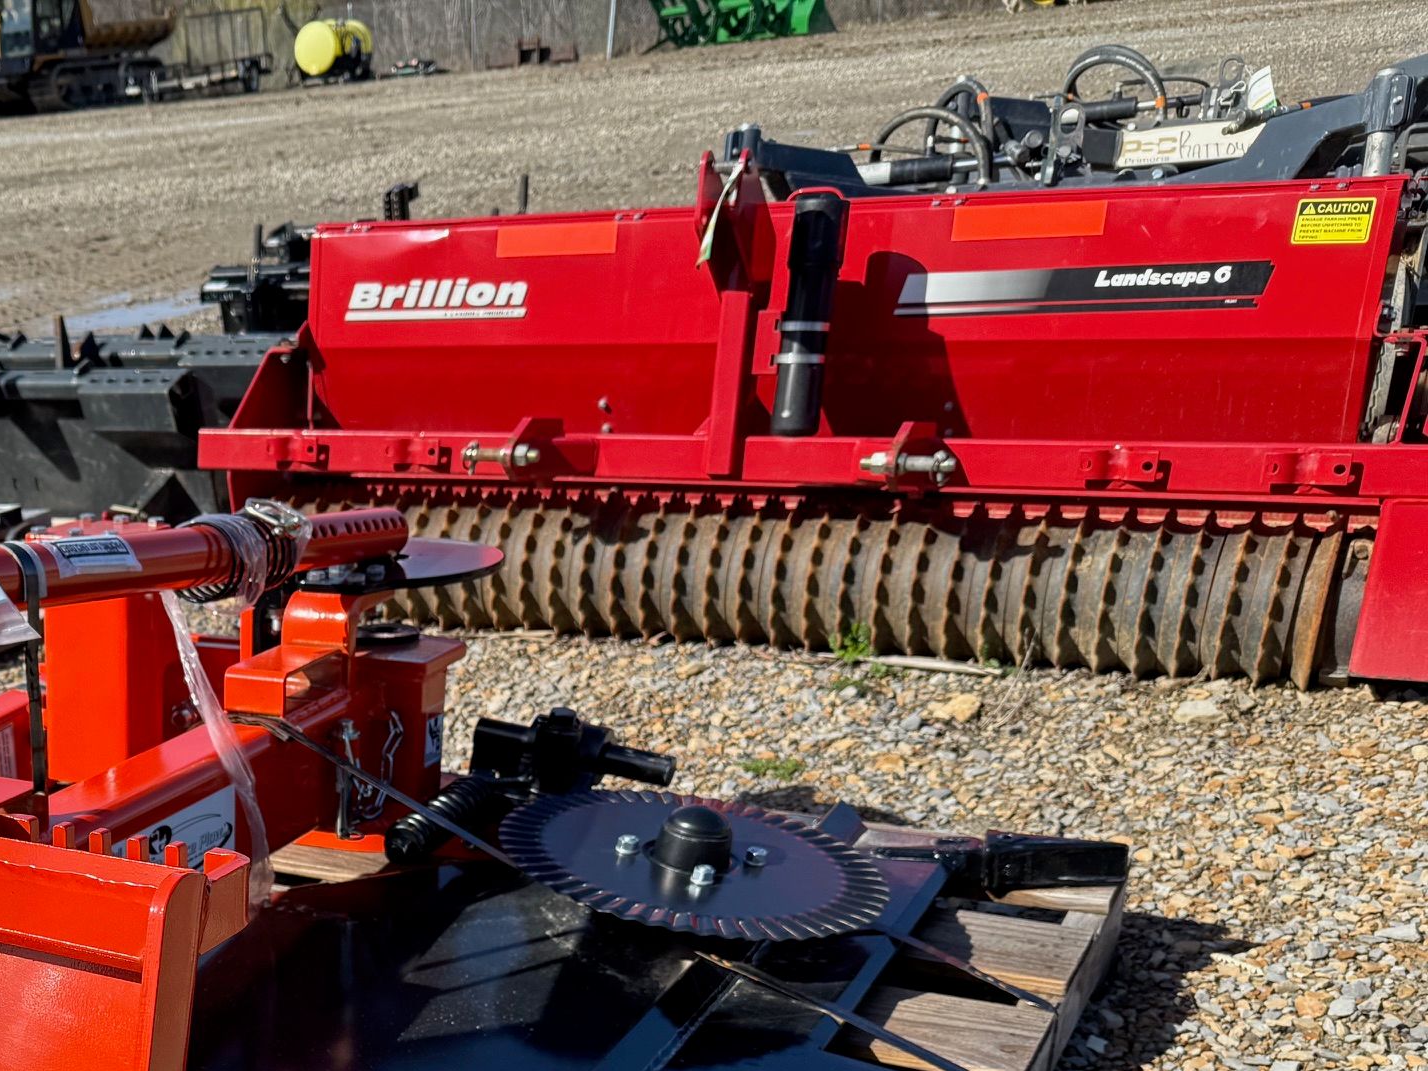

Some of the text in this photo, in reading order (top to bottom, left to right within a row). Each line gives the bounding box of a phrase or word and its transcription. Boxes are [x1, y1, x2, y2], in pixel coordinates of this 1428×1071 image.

[1317, 202, 1370, 214] CAUTION
[1094, 265, 1232, 287] Landscape 6
[348, 276, 528, 309] Brillion
